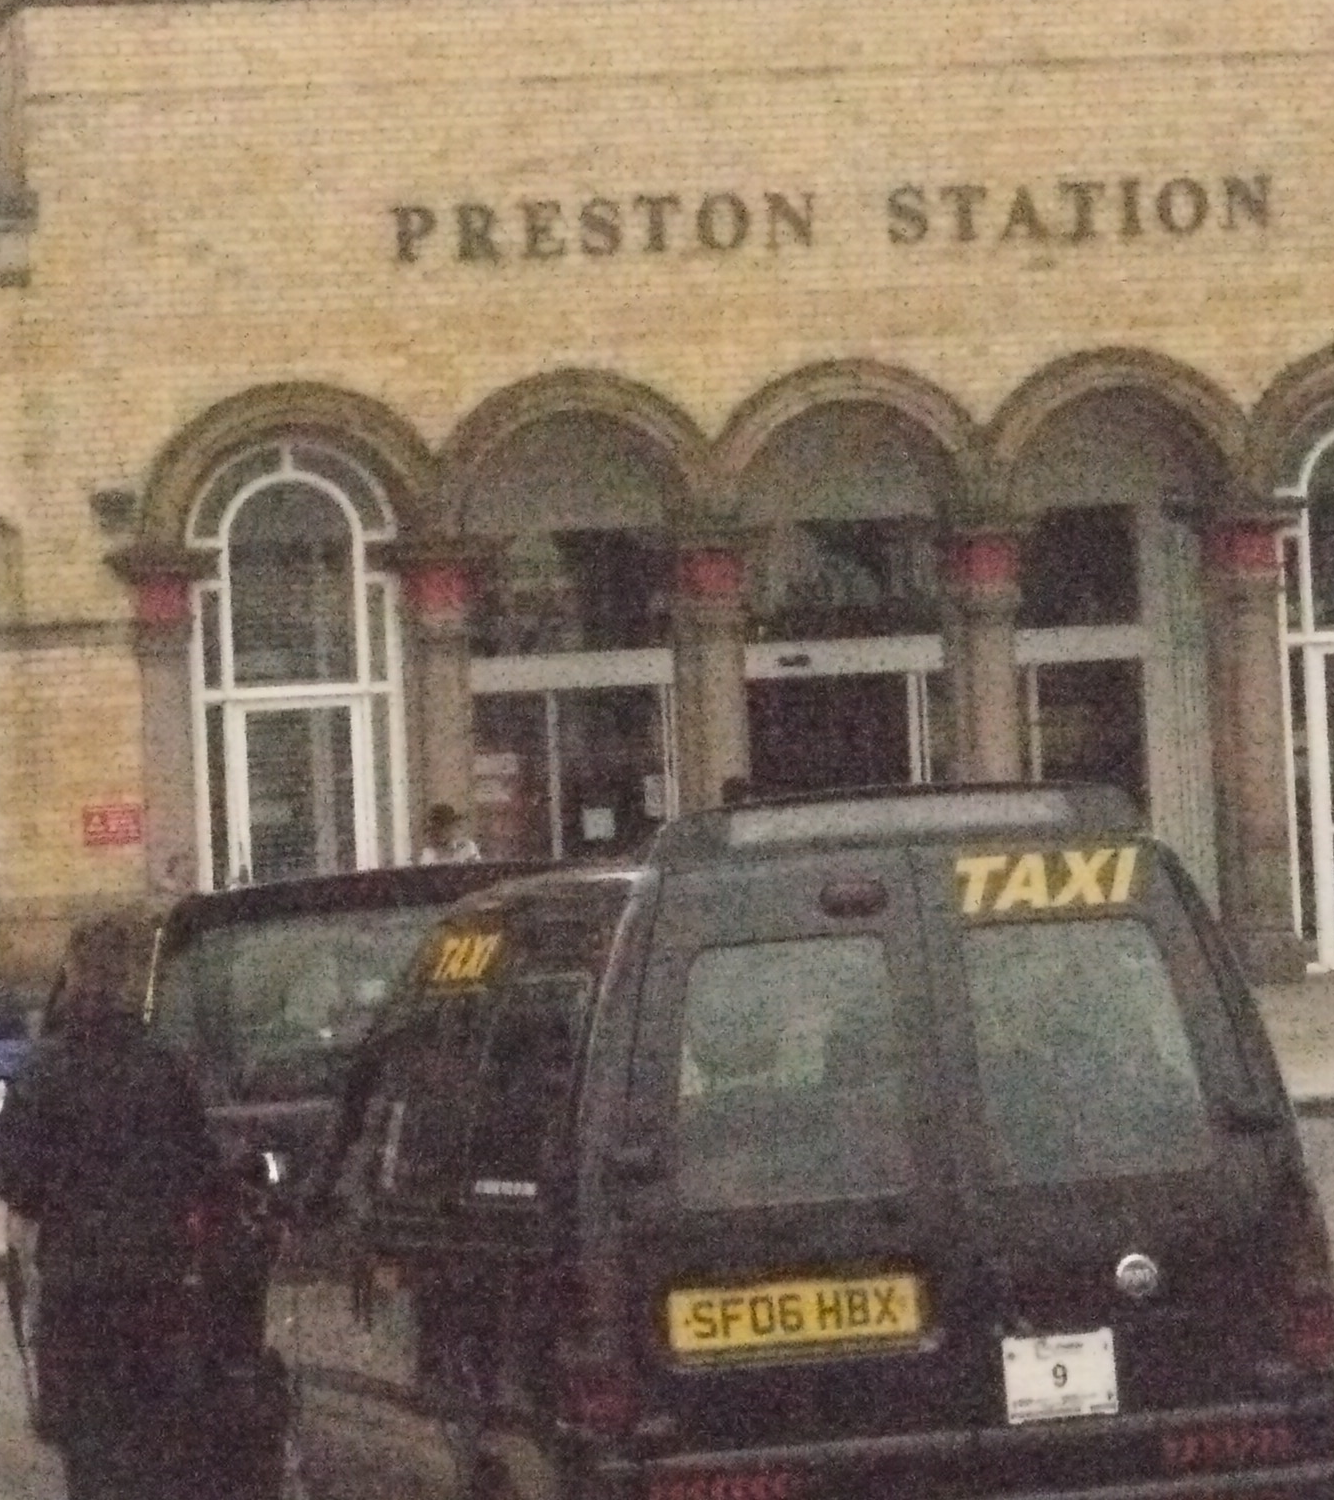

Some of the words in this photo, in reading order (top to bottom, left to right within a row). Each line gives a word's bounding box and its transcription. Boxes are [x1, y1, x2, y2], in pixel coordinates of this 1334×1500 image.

[389, 191, 817, 263] PRESTON
[885, 173, 1274, 246] STATION
[956, 845, 1139, 917] TAXI
[433, 933, 503, 981] TAXI
[690, 1293, 805, 1339] SF06
[815, 1286, 899, 1330] HBX
[1051, 1362, 1069, 1389] 9
